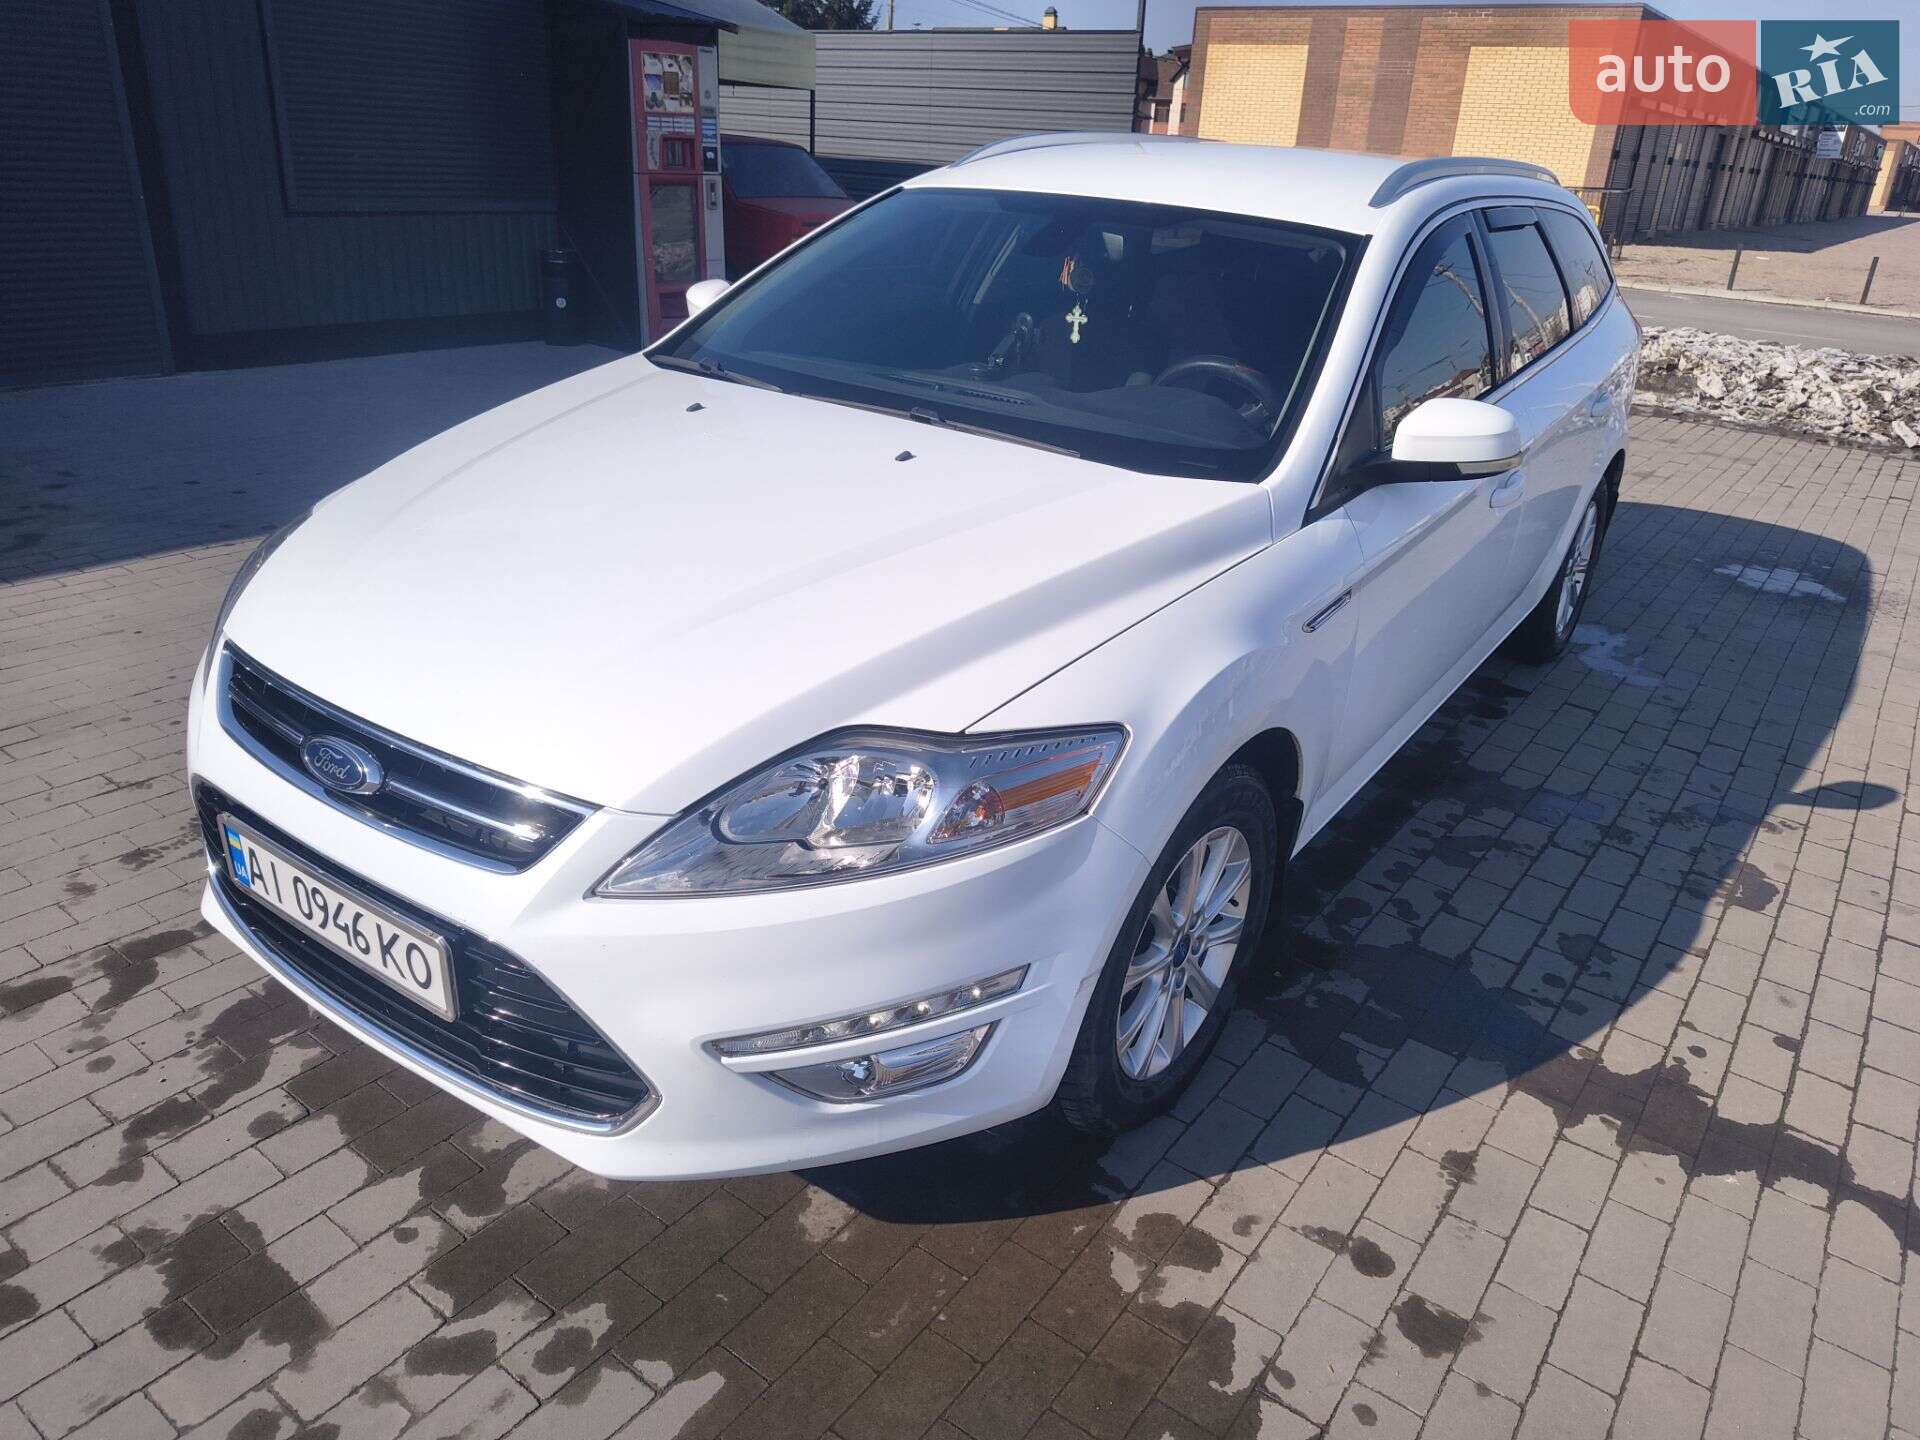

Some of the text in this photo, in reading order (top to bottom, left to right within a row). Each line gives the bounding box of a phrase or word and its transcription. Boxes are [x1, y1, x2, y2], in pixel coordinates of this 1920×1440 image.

[314, 747, 350, 780] Ford
[235, 860, 248, 878] UA
[293, 876, 370, 955] 0946
[376, 923, 431, 990] KO
